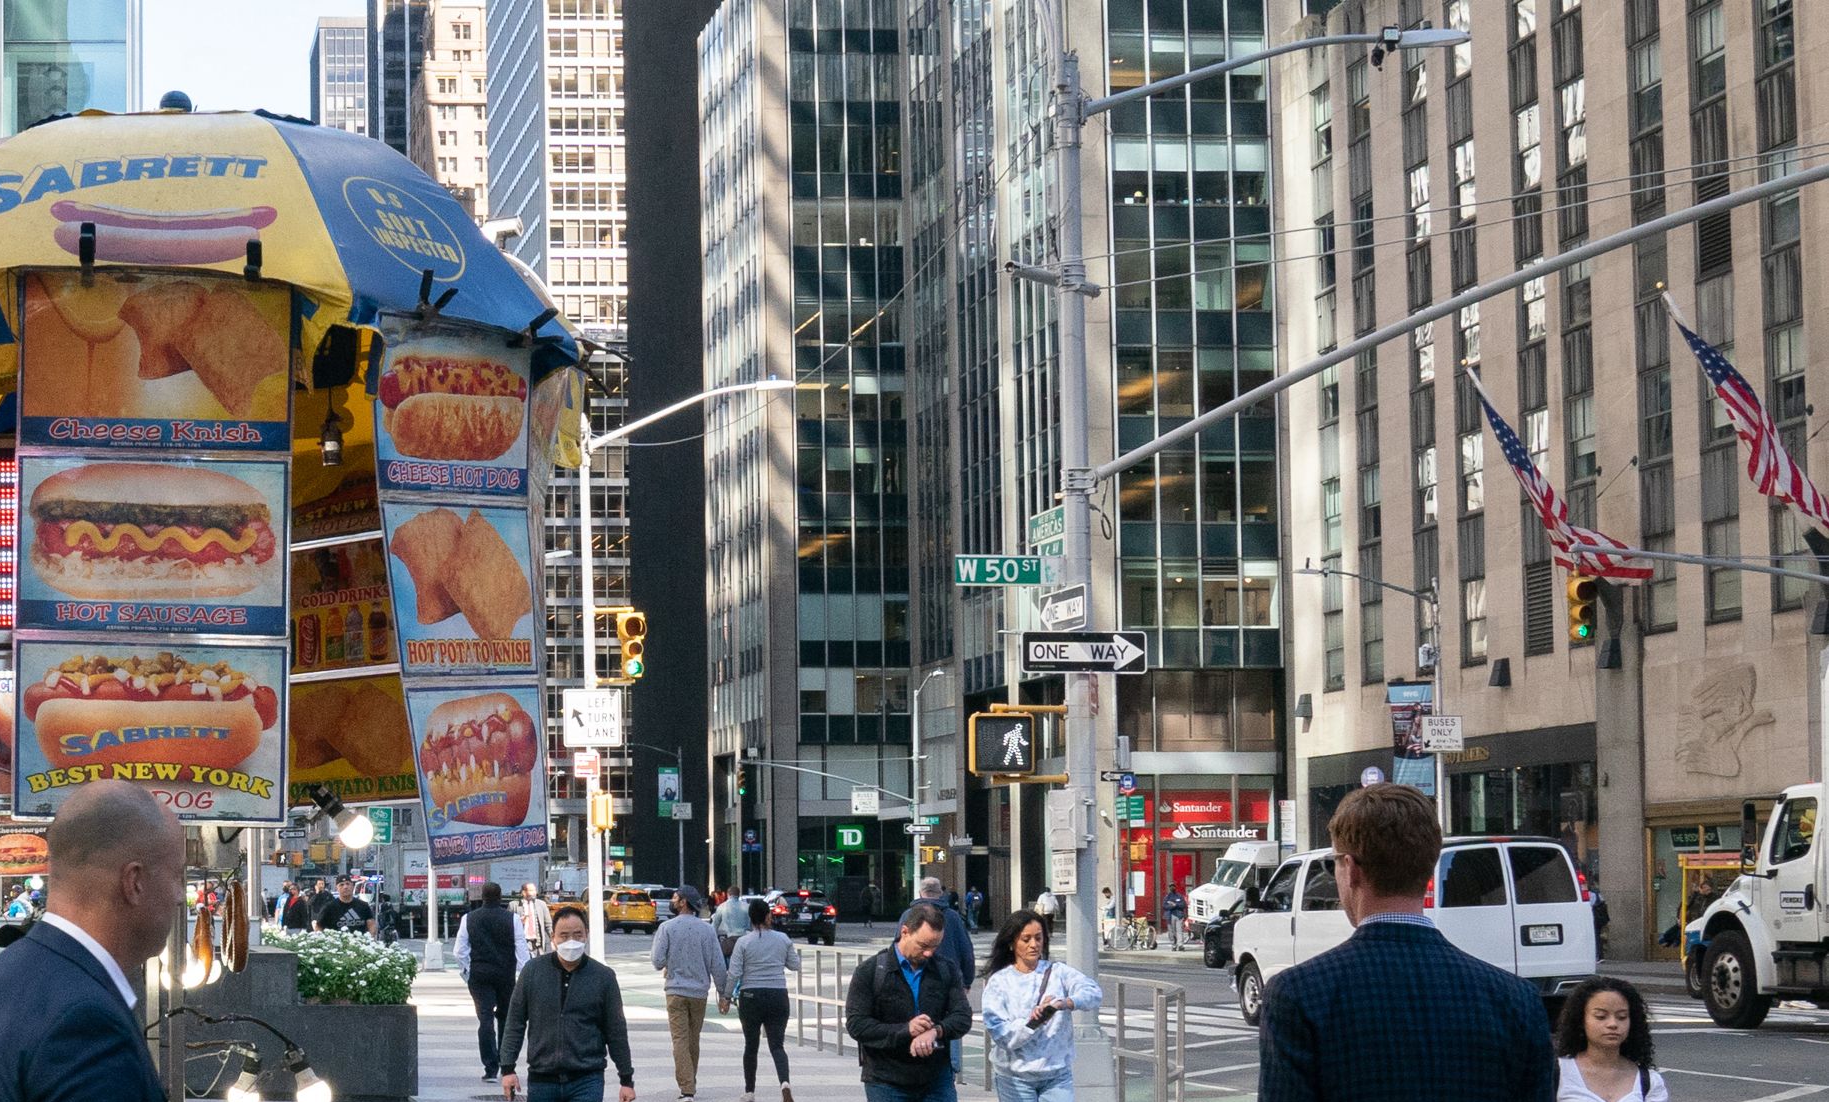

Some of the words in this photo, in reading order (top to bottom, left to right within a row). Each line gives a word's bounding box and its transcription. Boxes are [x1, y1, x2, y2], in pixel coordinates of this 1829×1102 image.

[373, 226, 460, 264] INSPECTED
[48, 416, 163, 442] Cheese
[170, 420, 263, 444] Knish
[388, 461, 450, 485] CHEESE
[453, 466, 486, 487] HOT
[486, 469, 521, 490] DOG
[1031, 517, 1063, 542] AMERICAS
[958, 558, 979, 583] W
[985, 558, 1020, 583] 50
[1022, 559, 1039, 573] ST
[301, 592, 337, 609] COLD
[1044, 604, 1060, 623] ONE
[1066, 598, 1082, 618] WAY
[55, 602, 112, 622] HOT
[117, 605, 248, 625] SAUSAGE
[406, 638, 438, 665] HOT
[492, 638, 533, 666] KNISH
[1033, 644, 1070, 660] ONE
[1090, 644, 1129, 660] WAY
[587, 697, 614, 708] LEFT
[587, 713, 616, 723] TURN
[1427, 718, 1456, 727] BUSES
[58, 724, 231, 756] SABRETT
[587, 727, 616, 738] LANE
[1431, 728, 1453, 737] ONLY
[26, 763, 105, 793] BEST
[112, 763, 183, 781] NEW
[189, 765, 274, 799] YORK
[378, 773, 416, 793] KNIS
[428, 790, 508, 830] SABRETT
[1172, 801, 1223, 814] Santander
[433, 836, 471, 859] JUMBO
[473, 832, 501, 852] GRILL
[502, 830, 523, 849] HOT
[523, 825, 546, 847] DOG
[837, 828, 863, 846] TD
[1191, 824, 1260, 839] Santander
[336, 918, 365, 929] adidas
